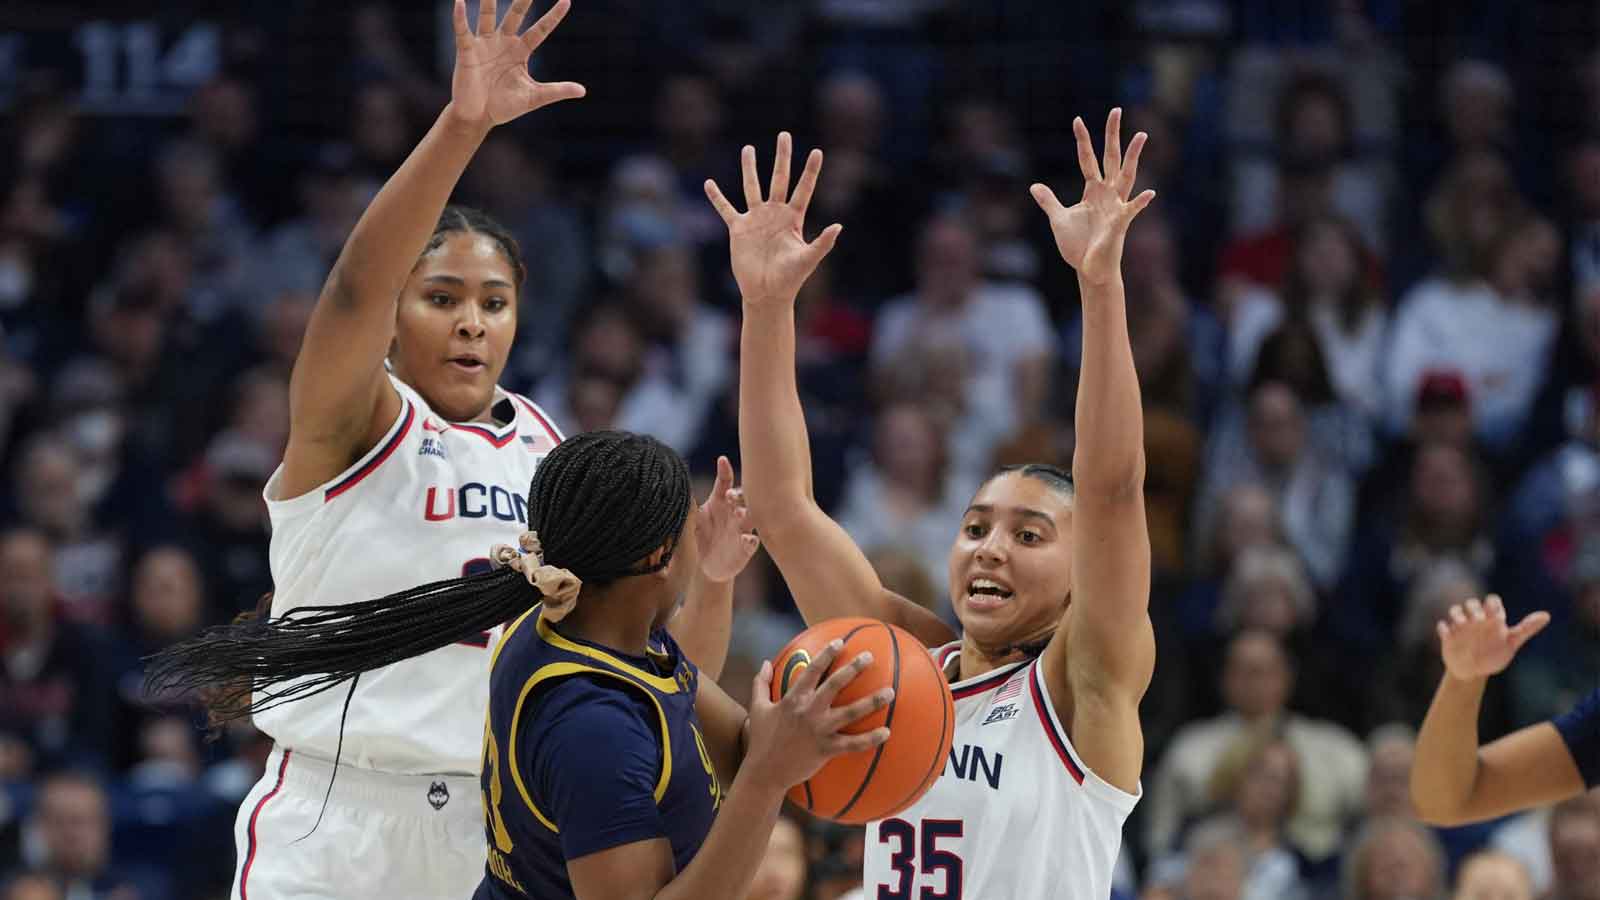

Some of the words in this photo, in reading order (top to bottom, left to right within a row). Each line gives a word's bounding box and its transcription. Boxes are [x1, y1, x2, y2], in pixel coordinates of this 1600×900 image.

[984, 709, 1020, 722] EAST
[991, 703, 1016, 715] BIG
[877, 817, 964, 900] 35
